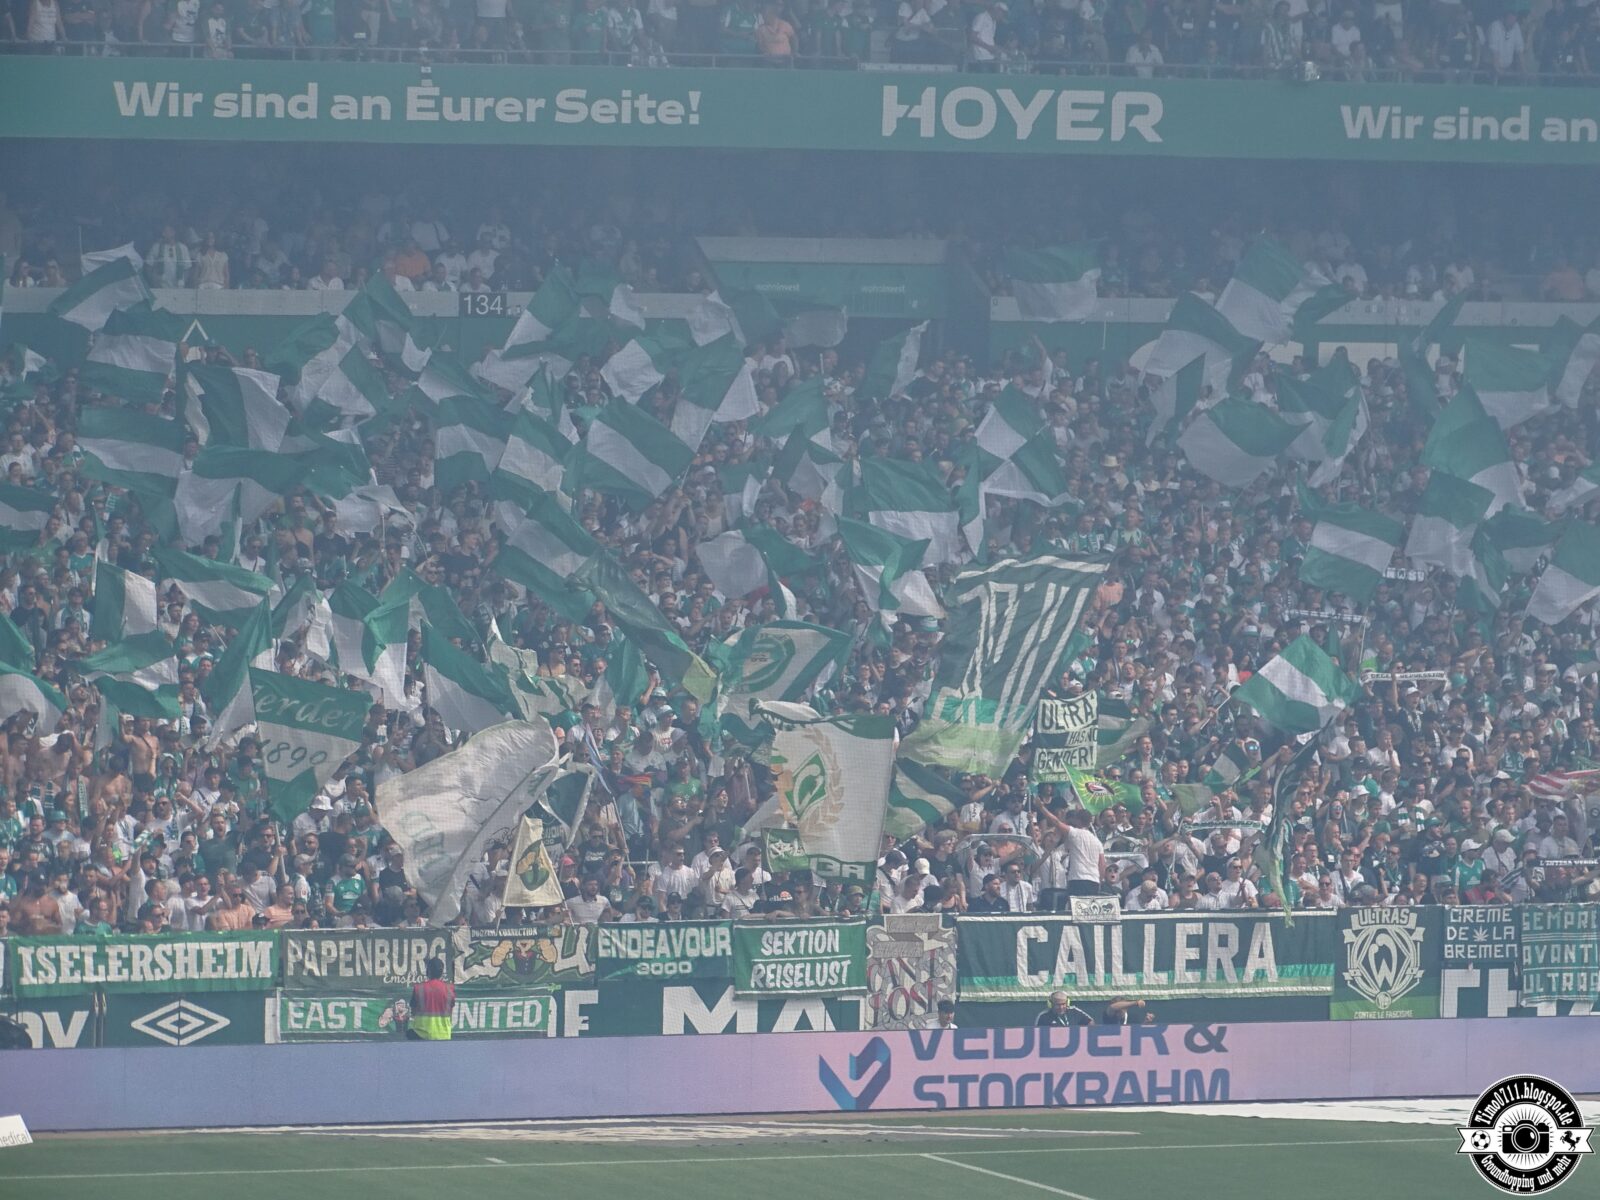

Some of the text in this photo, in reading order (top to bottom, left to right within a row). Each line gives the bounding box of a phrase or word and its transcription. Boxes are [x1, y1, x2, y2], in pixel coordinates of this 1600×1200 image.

[113, 81, 701, 125] Wir sind an Eurer Seite!
[881, 85, 1164, 143] HOYER
[1340, 105, 1599, 143] Wir sind an
[463, 293, 503, 315] 134
[1358, 908, 1410, 925] ULTRAS
[1450, 907, 1513, 924] CREME
[1522, 909, 1598, 931] SEMPRE
[597, 926, 732, 959] ENDEAVOUR
[760, 927, 840, 957] SEKTION
[1446, 925, 1515, 941] DE LA
[17, 940, 273, 985] ISELERSHEIM
[287, 936, 447, 977] PAPENBURG
[1016, 922, 1279, 988] CAILLERA
[1444, 943, 1518, 959] BREMEN
[1522, 943, 1598, 966] AVANTI
[636, 961, 692, 976] 3000
[750, 958, 851, 989] REISELUST
[1523, 971, 1600, 994] ULTRAS
[287, 1001, 368, 1029] EAST
[908, 1024, 1229, 1061] VEDDER &
[913, 1068, 1231, 1109] STOCKRAHM
